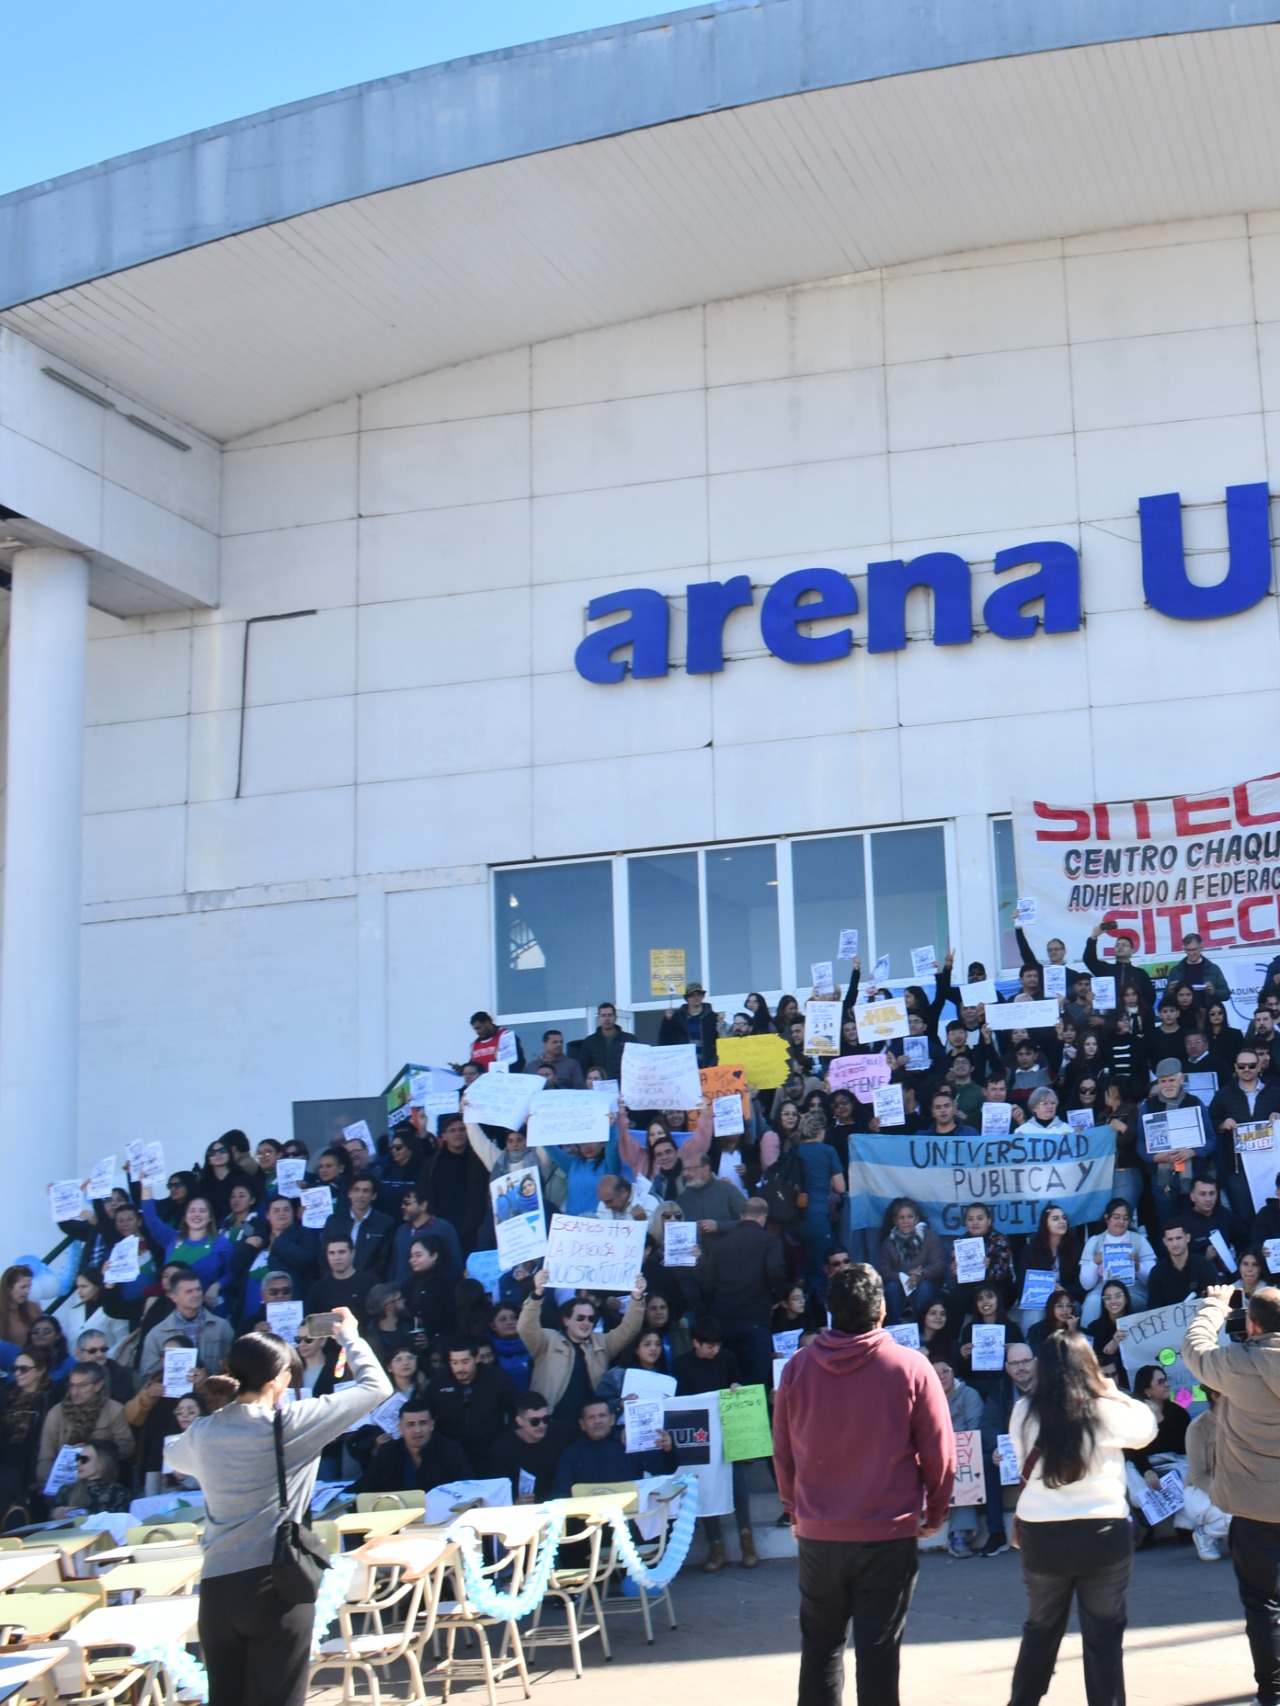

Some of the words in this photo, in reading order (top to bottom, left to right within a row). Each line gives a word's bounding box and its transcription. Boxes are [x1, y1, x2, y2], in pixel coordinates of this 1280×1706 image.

[573, 538, 1084, 685] arena
[1064, 844, 1178, 878] CENTRO
[1068, 879, 1170, 910] ADHERIDO
[1174, 876, 1188, 902] A
[909, 1134, 1090, 1170] UNIVERSIDAD
[1074, 1160, 1096, 1192] Y
[1129, 1310, 1170, 1344] DESDE
[1173, 1303, 1199, 1328] OPT
[956, 1432, 973, 1447] EY
[956, 1448, 973, 1465] EY
